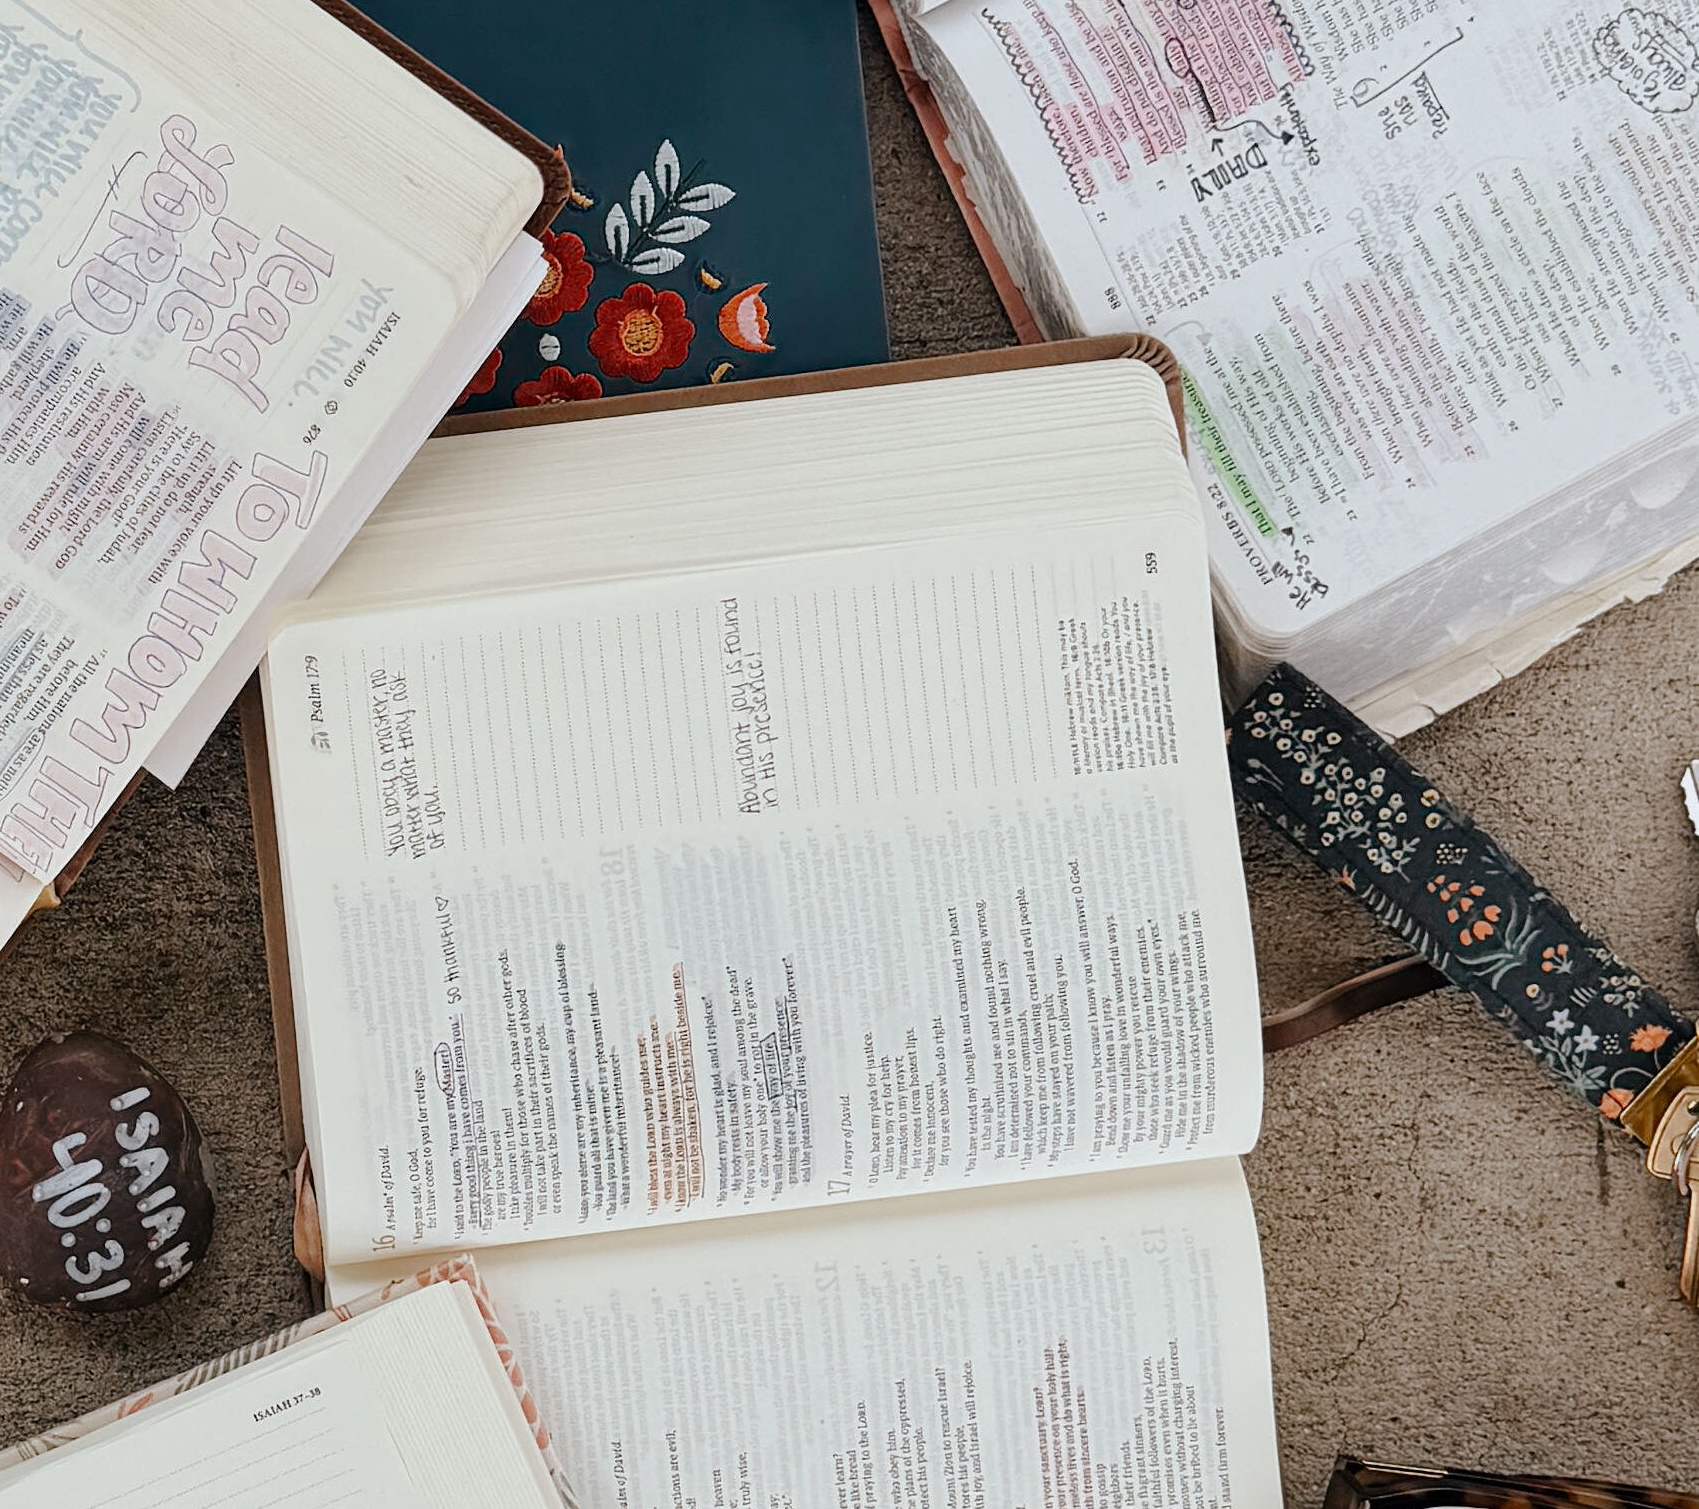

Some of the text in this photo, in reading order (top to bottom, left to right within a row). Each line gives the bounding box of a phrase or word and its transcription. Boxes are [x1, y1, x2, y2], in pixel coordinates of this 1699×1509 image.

[53, 113, 236, 336] LORD
[155, 215, 260, 354] me
[186, 223, 335, 414] lead
[342, 310, 401, 388] ISAIAH 40:10
[301, 423, 321, 445] 876
[1144, 551, 1158, 574] 559
[1206, 482, 1273, 585] PROVERBS 8:22
[303, 654, 323, 723] Psalm 17:9
[369, 668, 387, 689] no
[719, 596, 761, 814] Abundant joy is found
[743, 651, 779, 807] in His presence!
[380, 757, 396, 772] a
[381, 774, 403, 817] obey
[388, 669, 426, 860] matter what they ask
[384, 821, 406, 857] You
[425, 828, 445, 850] of
[435, 912, 460, 983] thankful
[32, 1086, 194, 1302] ISAIAH 40:31
[826, 1179, 851, 1197] 17
[371, 1234, 396, 1252] 16
[252, 1398, 292, 1422] ISAIAH
